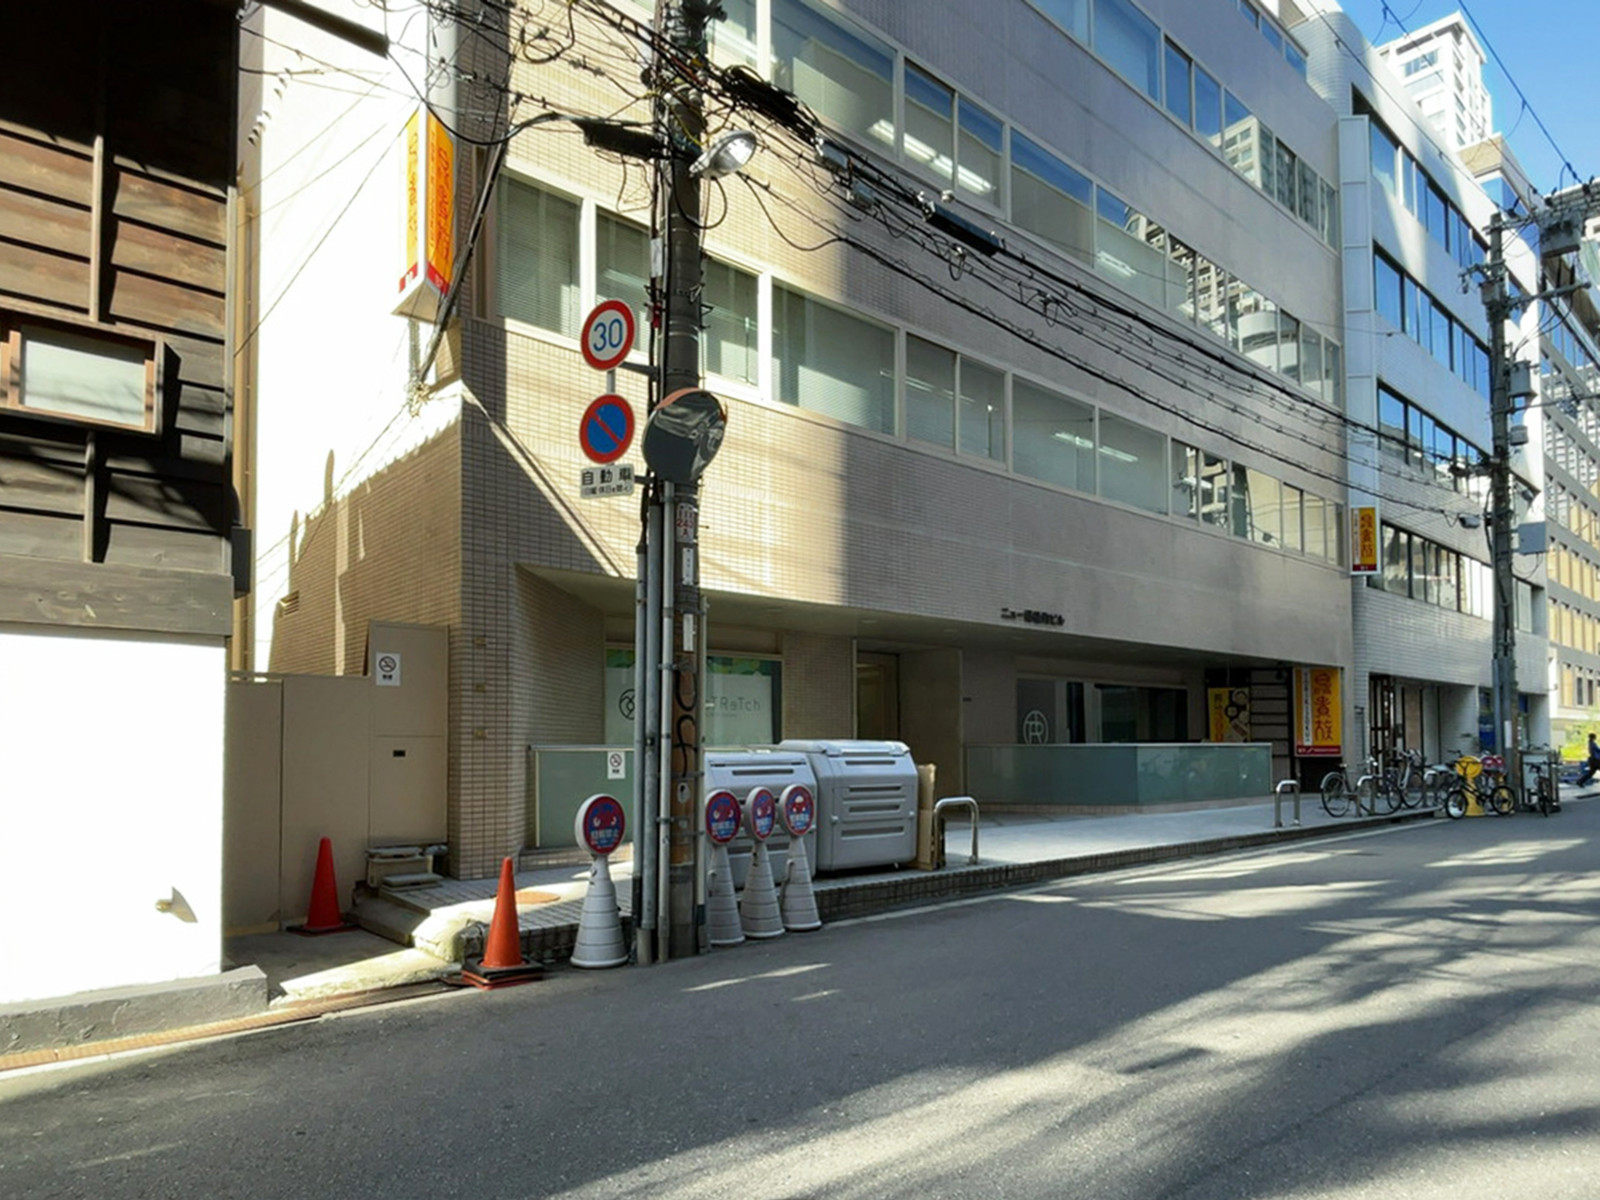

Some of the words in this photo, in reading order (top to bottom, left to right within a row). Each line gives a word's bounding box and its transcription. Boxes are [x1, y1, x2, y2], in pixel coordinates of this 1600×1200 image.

[592, 318, 622, 352] 30
[1313, 671, 1334, 742] 鳥貴族
